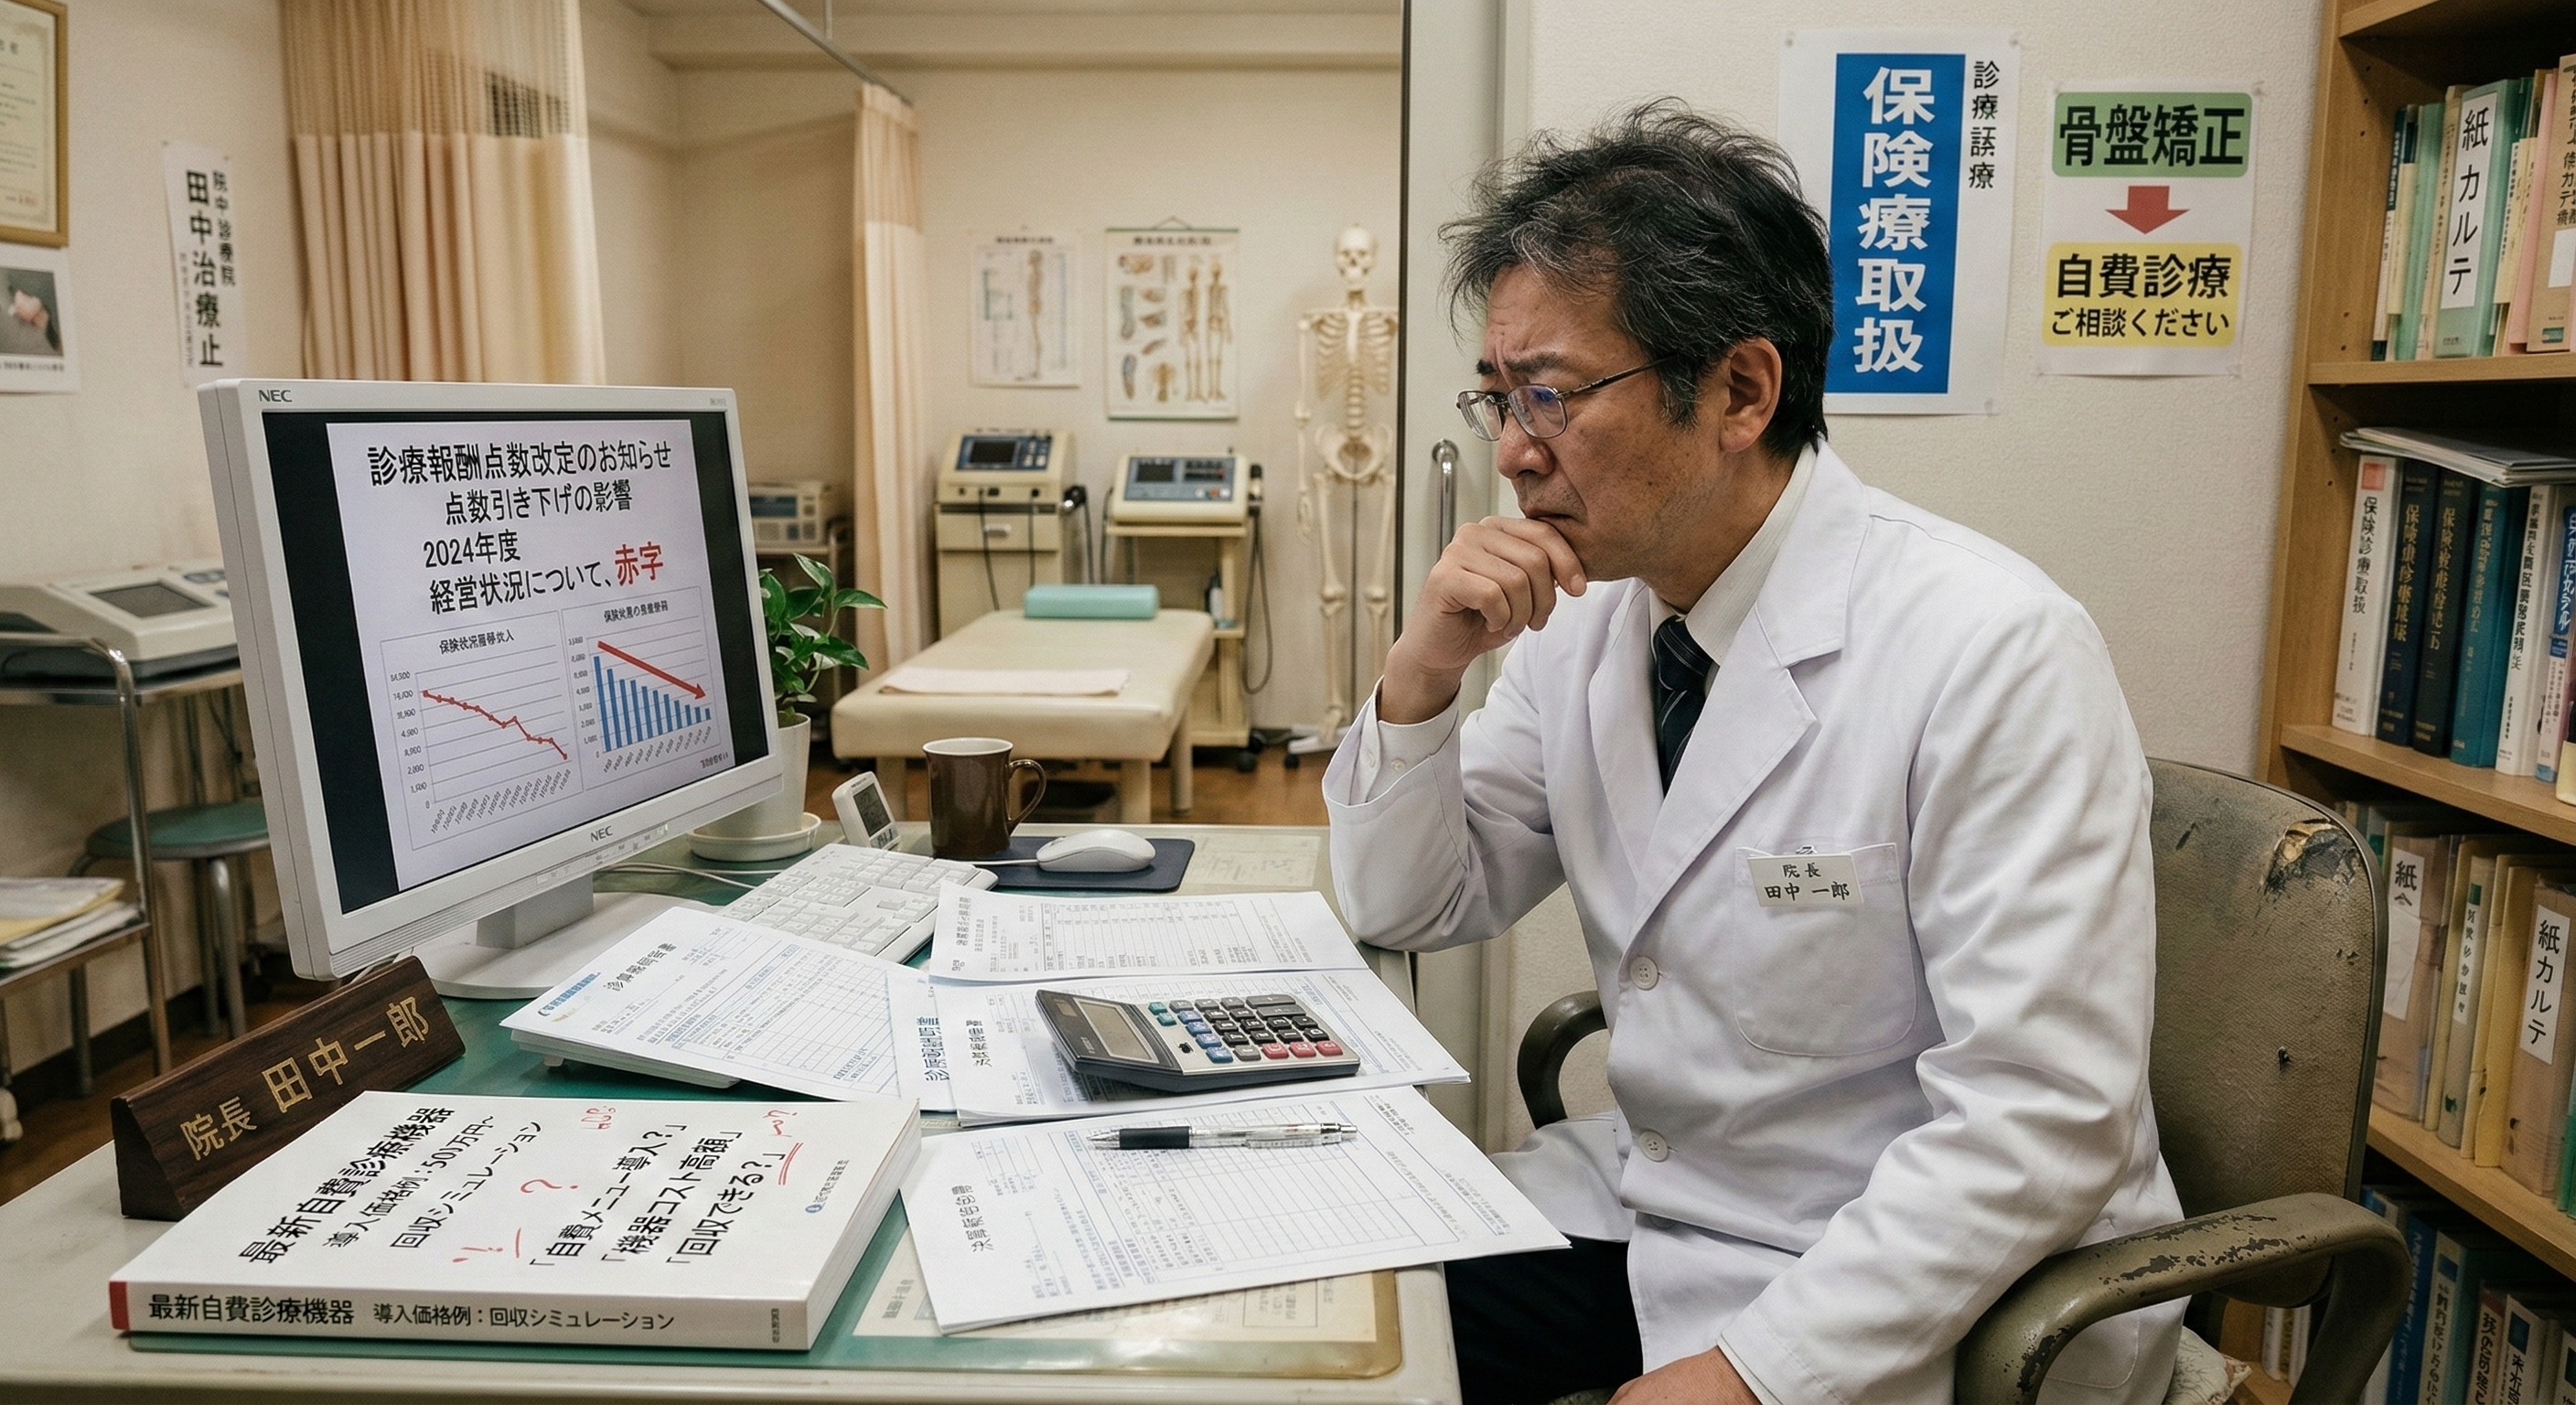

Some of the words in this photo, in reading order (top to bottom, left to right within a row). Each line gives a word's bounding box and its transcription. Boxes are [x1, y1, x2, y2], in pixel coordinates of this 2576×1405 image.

[2058, 103, 2247, 167] 骨盤矯正
[1852, 66, 1936, 373] 保険療取扱
[2449, 106, 2489, 295] 紙カルテ
[2055, 252, 2232, 300] 自費診療
[2051, 307, 2230, 338] ご相談ください
[258, 390, 293, 402] NEC
[368, 440, 671, 487] 診療報酬点数改定のお知らせ
[445, 479, 633, 526] 点数引き下げの影響
[423, 529, 521, 569] 2024年度
[590, 825, 614, 842] NEC
[1782, 862, 1822, 878] 院長
[2528, 919, 2560, 1045] 紙カルテ
[180, 1096, 258, 1162] 院長
[261, 995, 431, 1114] 田中一郎
[238, 1107, 456, 1264] 最新自費診療機器
[389, 1121, 542, 1249] 回収シミュレーション
[600, 1131, 744, 1262] 「機器コスト高額」
[147, 1293, 355, 1325] 最新自費診療機器
